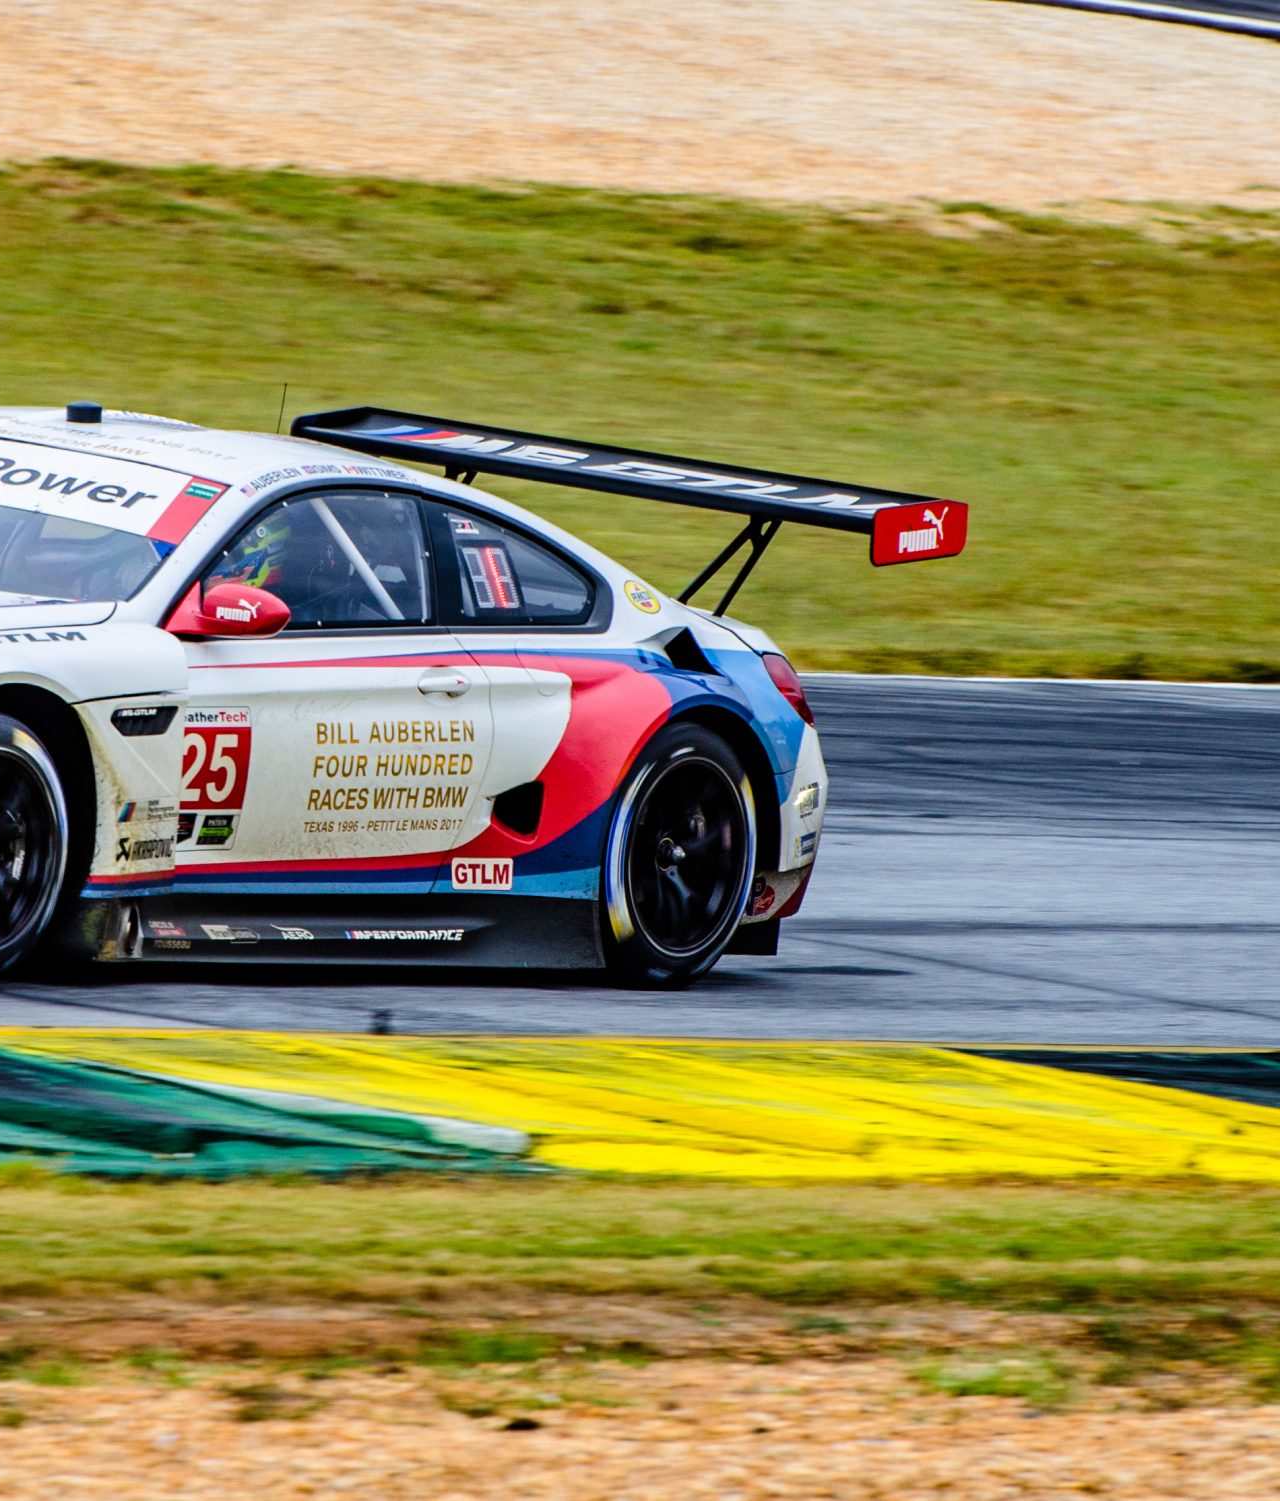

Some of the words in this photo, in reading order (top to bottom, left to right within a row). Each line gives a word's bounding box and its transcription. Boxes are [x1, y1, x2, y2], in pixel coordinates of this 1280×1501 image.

[250, 466, 303, 490] AUBERLEN
[357, 465, 408, 482] WITTMER
[420, 434, 590, 466] M6
[580, 461, 902, 515] GTLM
[898, 527, 937, 554] PUMA
[215, 606, 251, 622] PUMA
[316, 722, 360, 745] BILL
[369, 720, 475, 744] AUBERLEN
[180, 732, 239, 803] 25
[313, 754, 368, 778] FOUR
[375, 753, 474, 777] HUNDRED
[307, 787, 369, 811] RACES
[373, 787, 420, 810] WITH
[422, 786, 469, 809] BMW
[303, 821, 335, 833] TEXAS
[337, 820, 359, 833] 1996
[366, 820, 396, 832] PETIT
[396, 820, 407, 832] LE
[410, 819, 438, 831] MANS
[440, 818, 464, 831] 2017
[454, 863, 510, 885] GTLM
